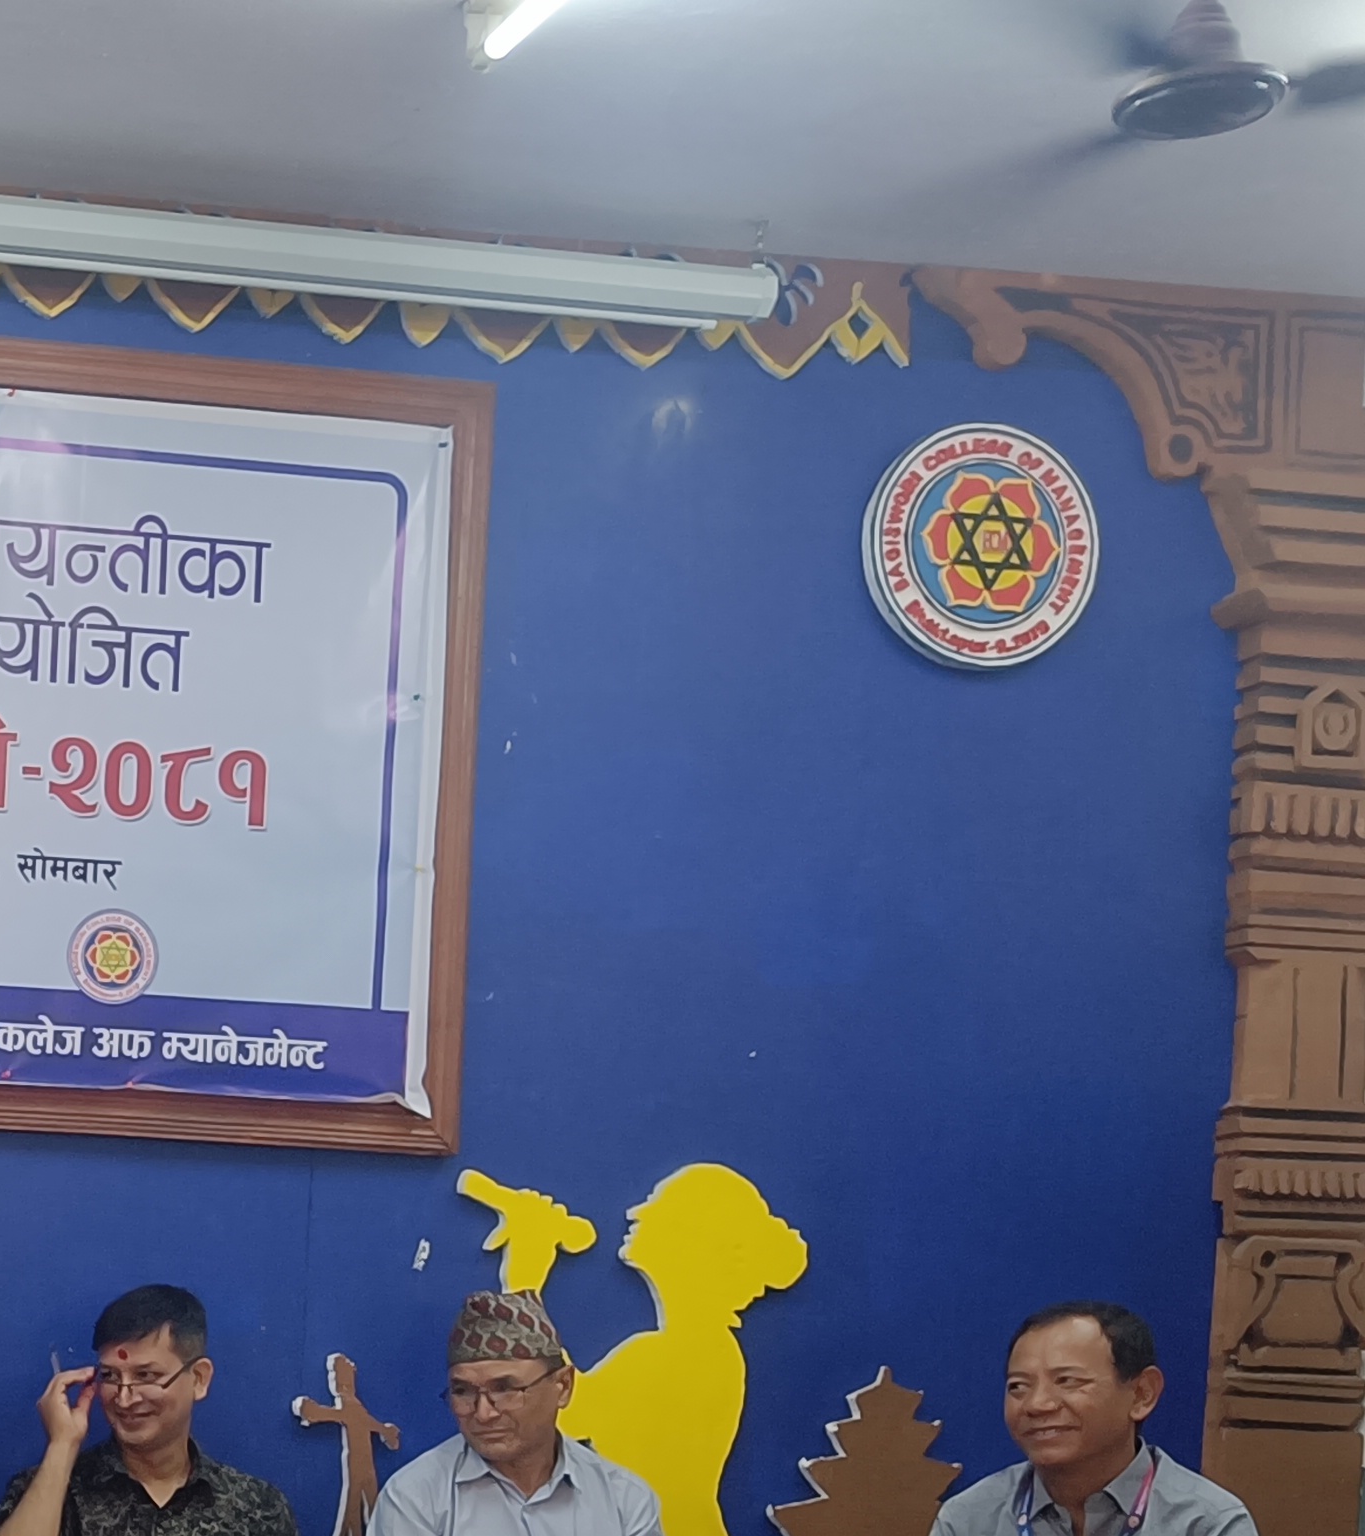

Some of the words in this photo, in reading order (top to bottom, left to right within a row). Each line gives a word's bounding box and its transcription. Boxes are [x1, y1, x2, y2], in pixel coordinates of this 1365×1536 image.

[17, 847, 122, 890] सोमबार
[91, 1027, 156, 1060] अफ
[162, 1026, 327, 1070] म्यानेजमेन्ट
